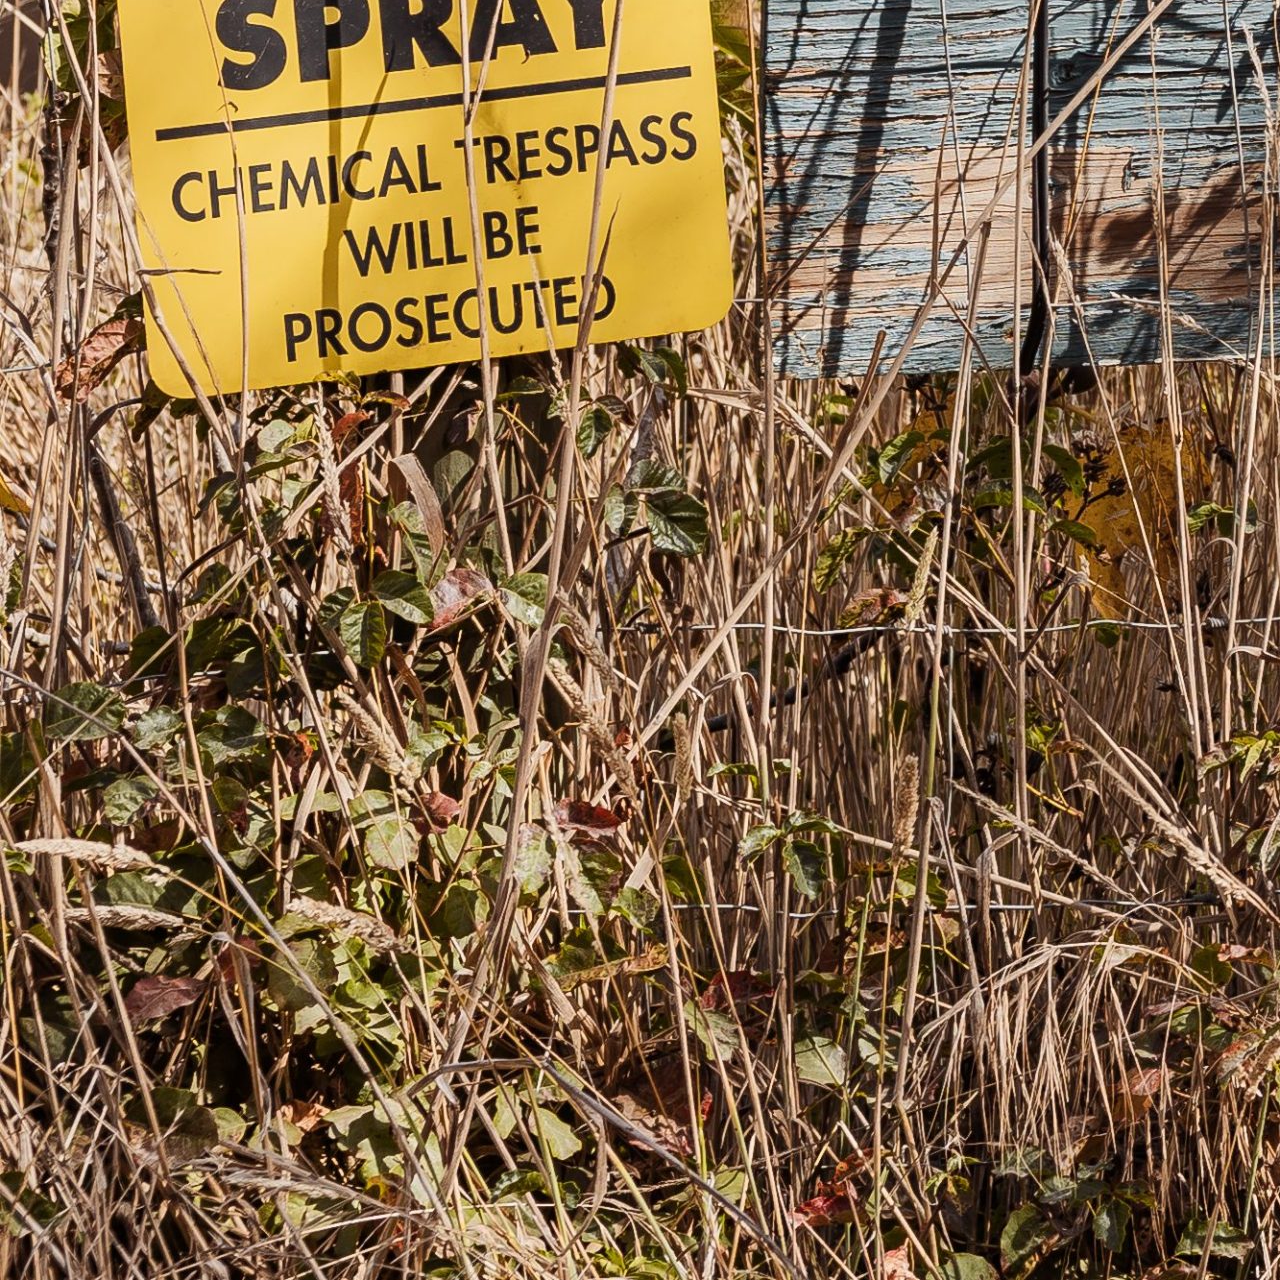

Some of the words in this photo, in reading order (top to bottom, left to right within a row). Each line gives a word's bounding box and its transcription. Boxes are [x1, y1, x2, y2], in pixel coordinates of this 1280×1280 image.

[171, 143, 442, 222] CHEMICAL
[454, 111, 698, 187] TRESPASS
[343, 216, 467, 277] WILL
[484, 206, 542, 259] BE
[284, 274, 617, 363] PROSECUTED
